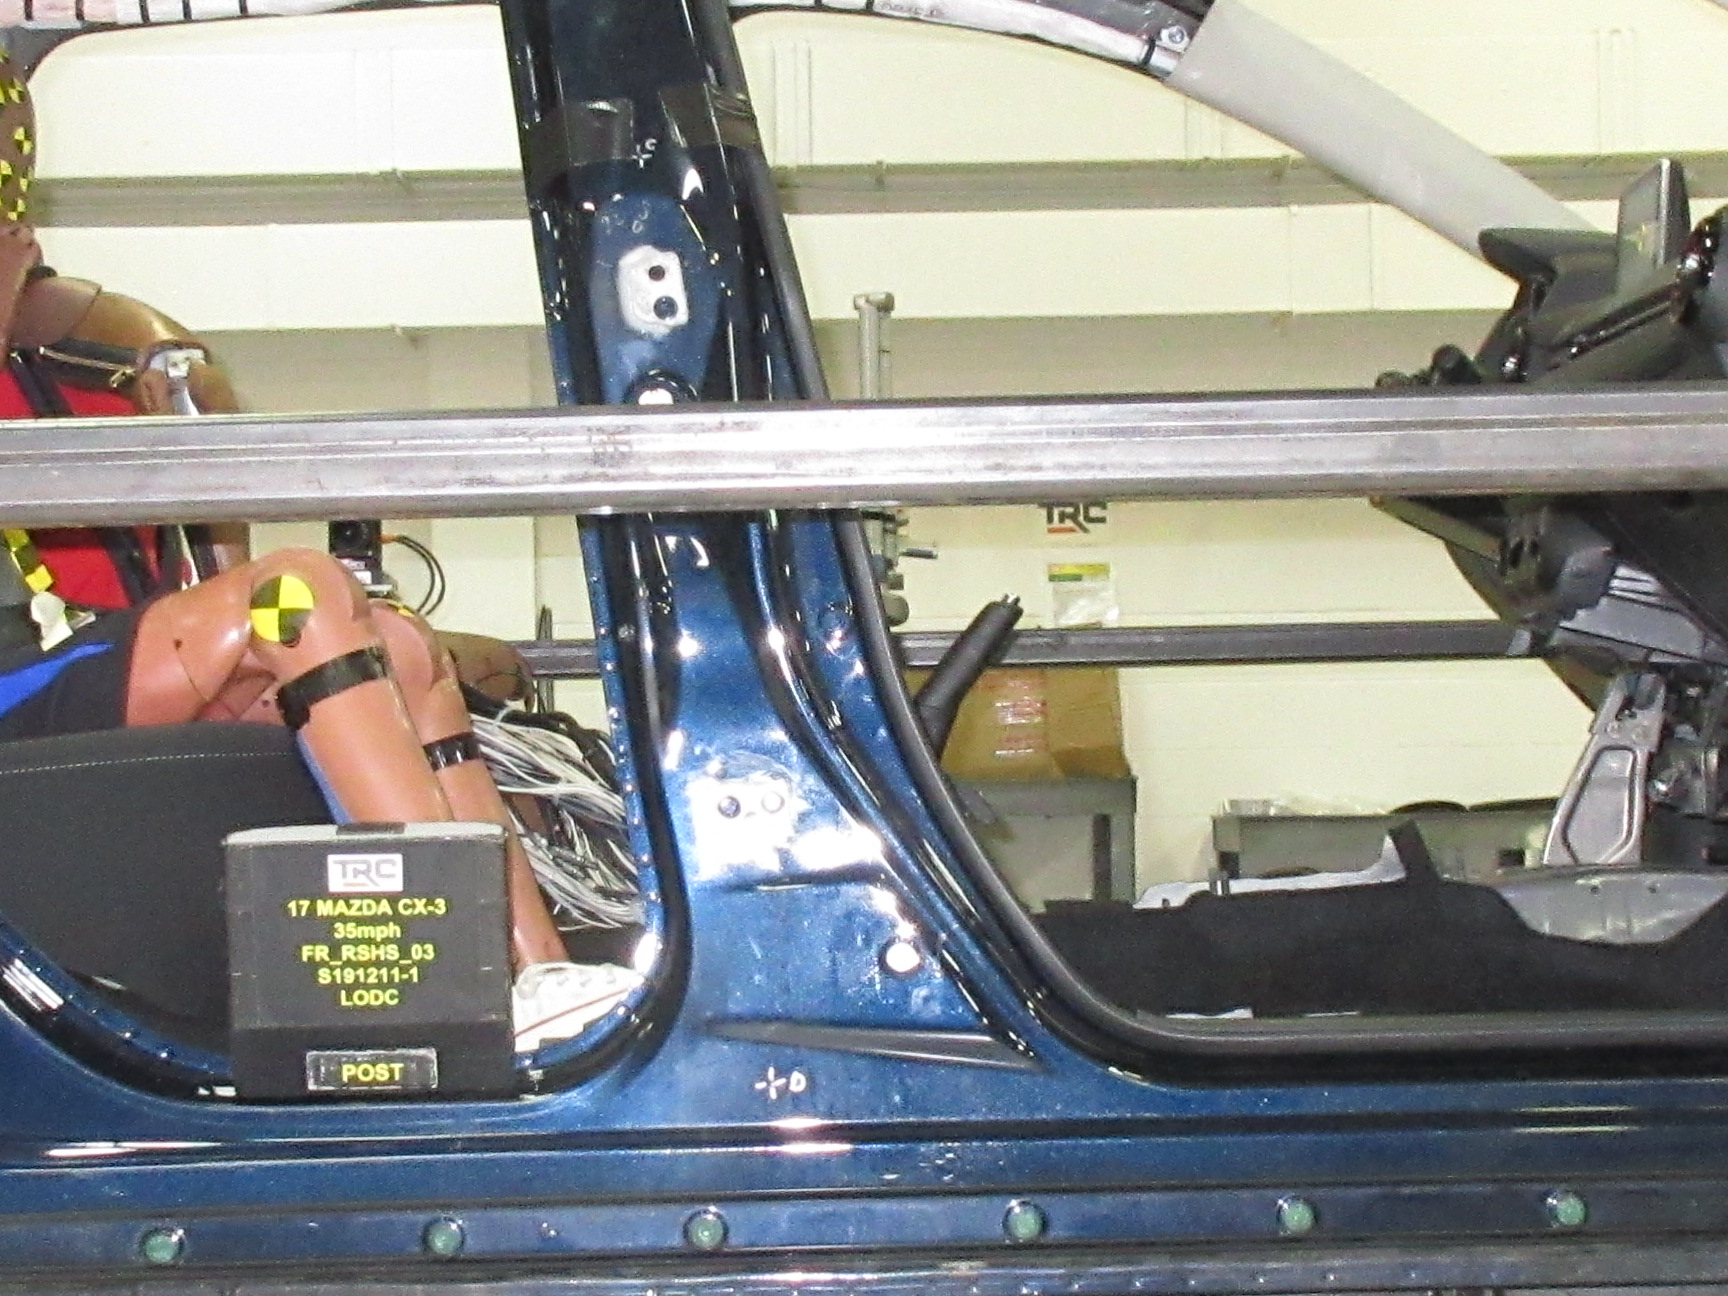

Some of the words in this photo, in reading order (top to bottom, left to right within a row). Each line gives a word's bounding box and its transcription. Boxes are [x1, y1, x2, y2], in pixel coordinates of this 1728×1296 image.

[333, 859, 397, 887] TRC
[287, 899, 311, 917] 17
[316, 899, 393, 916] MAZDA
[398, 898, 447, 915] CX-3
[333, 921, 402, 942] 35mph
[301, 944, 435, 966] FR_RSHS_03
[318, 966, 419, 985] S191211-1
[340, 988, 400, 1006] LODC
[342, 1063, 405, 1082] POST
